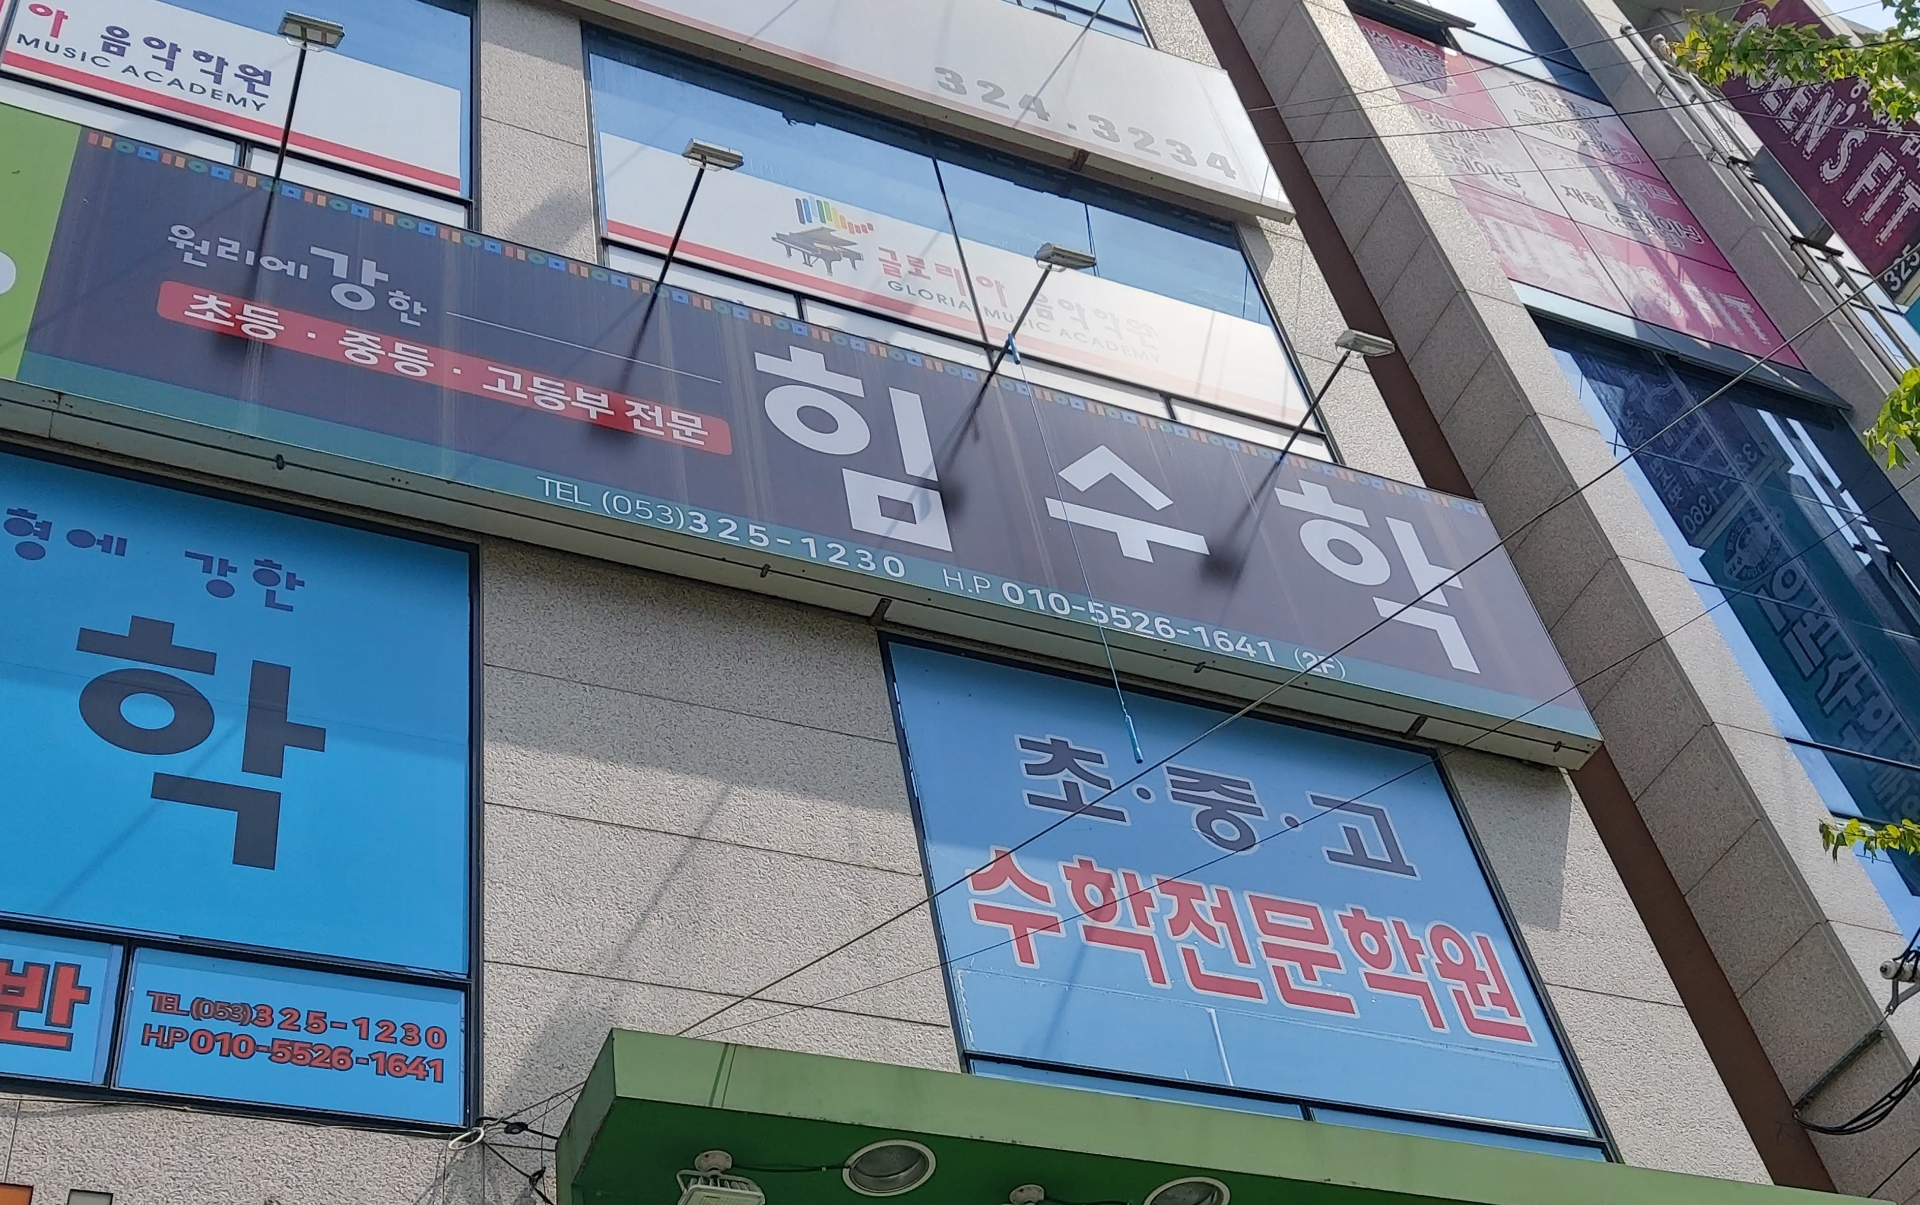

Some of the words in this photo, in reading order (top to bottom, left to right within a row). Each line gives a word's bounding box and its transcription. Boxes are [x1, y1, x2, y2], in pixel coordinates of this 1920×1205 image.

[17, 33, 112, 68] MUSIC
[121, 65, 267, 112] ACADEMY
[28, 3, 68, 38] 아
[100, 25, 272, 99] 음악학원
[933, 66, 1238, 180] 324.3234
[878, 246, 1007, 308] 글로리아
[887, 280, 972, 312] GLORIA
[984, 305, 1052, 333] MUSIC
[1059, 326, 1161, 364] ACADEMY
[482, 365, 615, 420] 고등부
[624, 398, 709, 446] 전문
[185, 551, 305, 612] 강한
[536, 475, 592, 507] TEL
[602, 490, 906, 579] (053)325-1230
[943, 568, 992, 595] H.P
[1001, 581, 1278, 664] 010-5526-1641
[76, 615, 327, 870] 학
